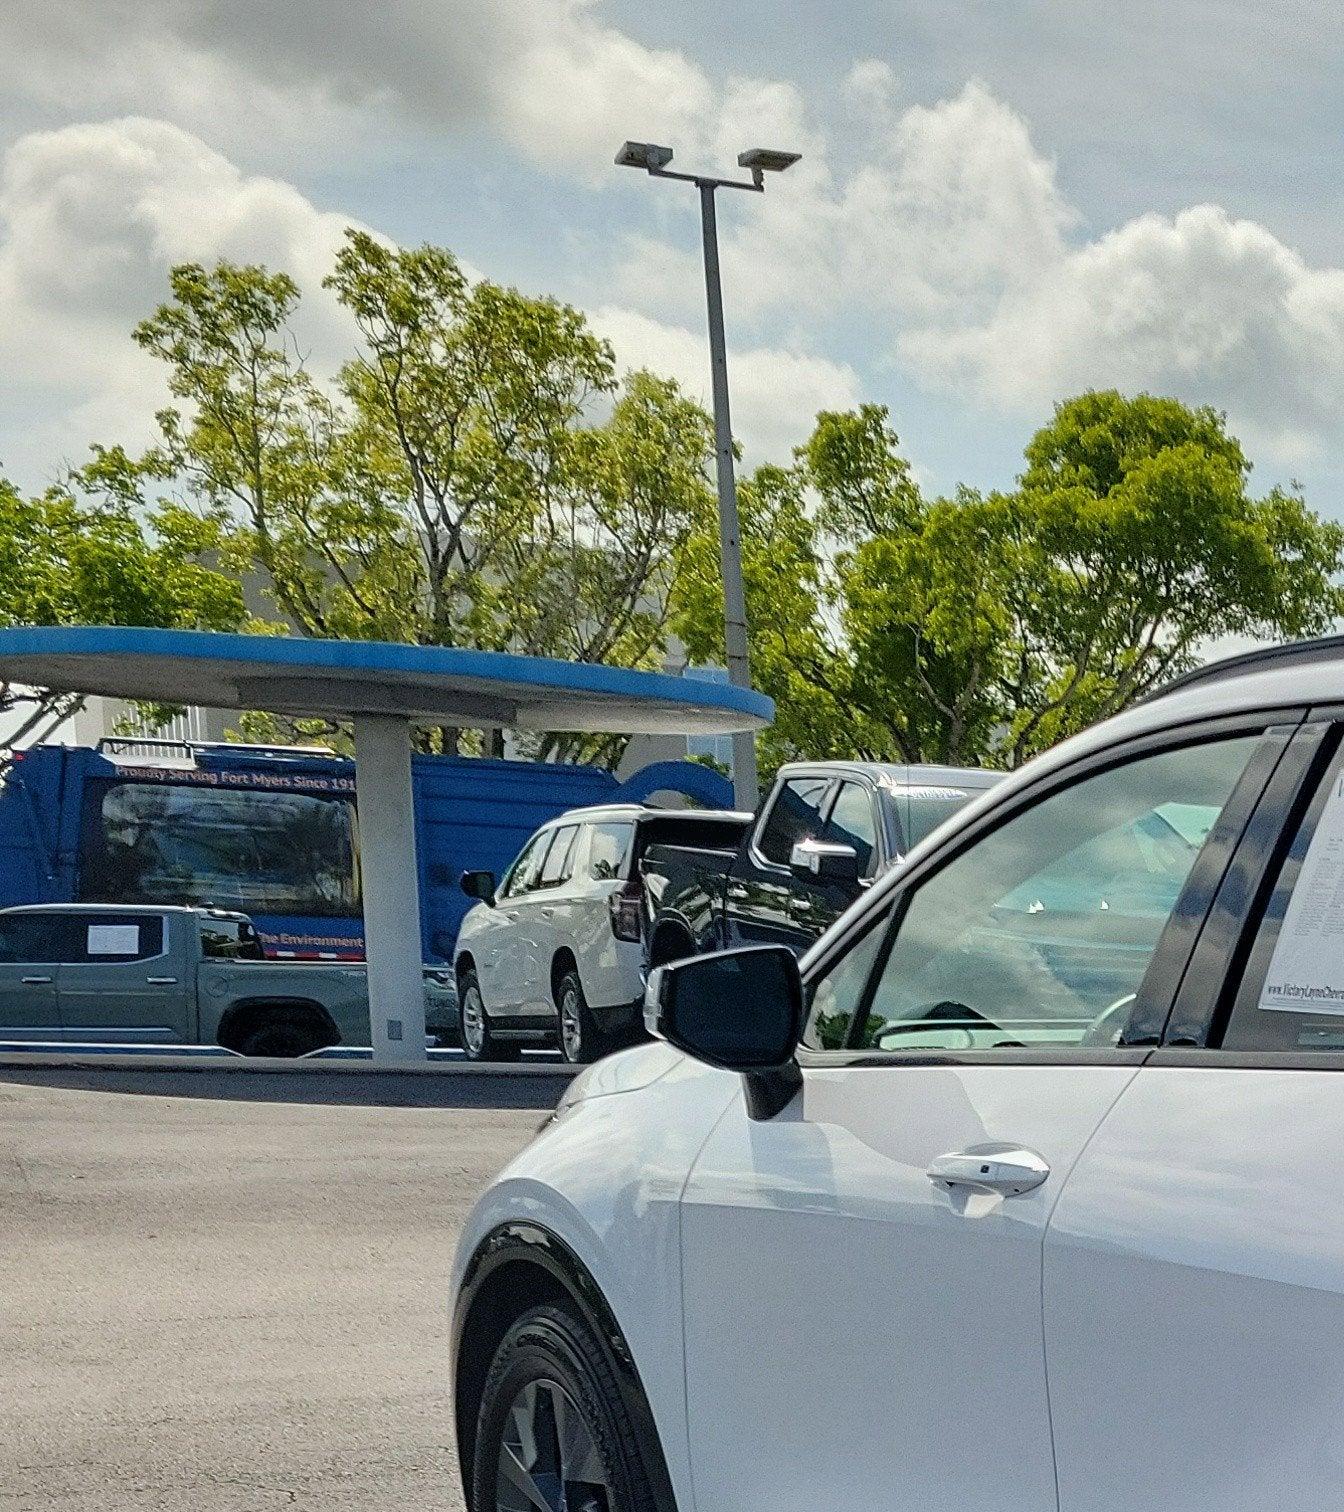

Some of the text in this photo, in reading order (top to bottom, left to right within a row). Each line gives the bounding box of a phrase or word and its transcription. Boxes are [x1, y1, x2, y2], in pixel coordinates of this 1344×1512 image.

[115, 765, 357, 791] Proudly Serving Fort Myers Since 191
[280, 932, 364, 948] Environment
